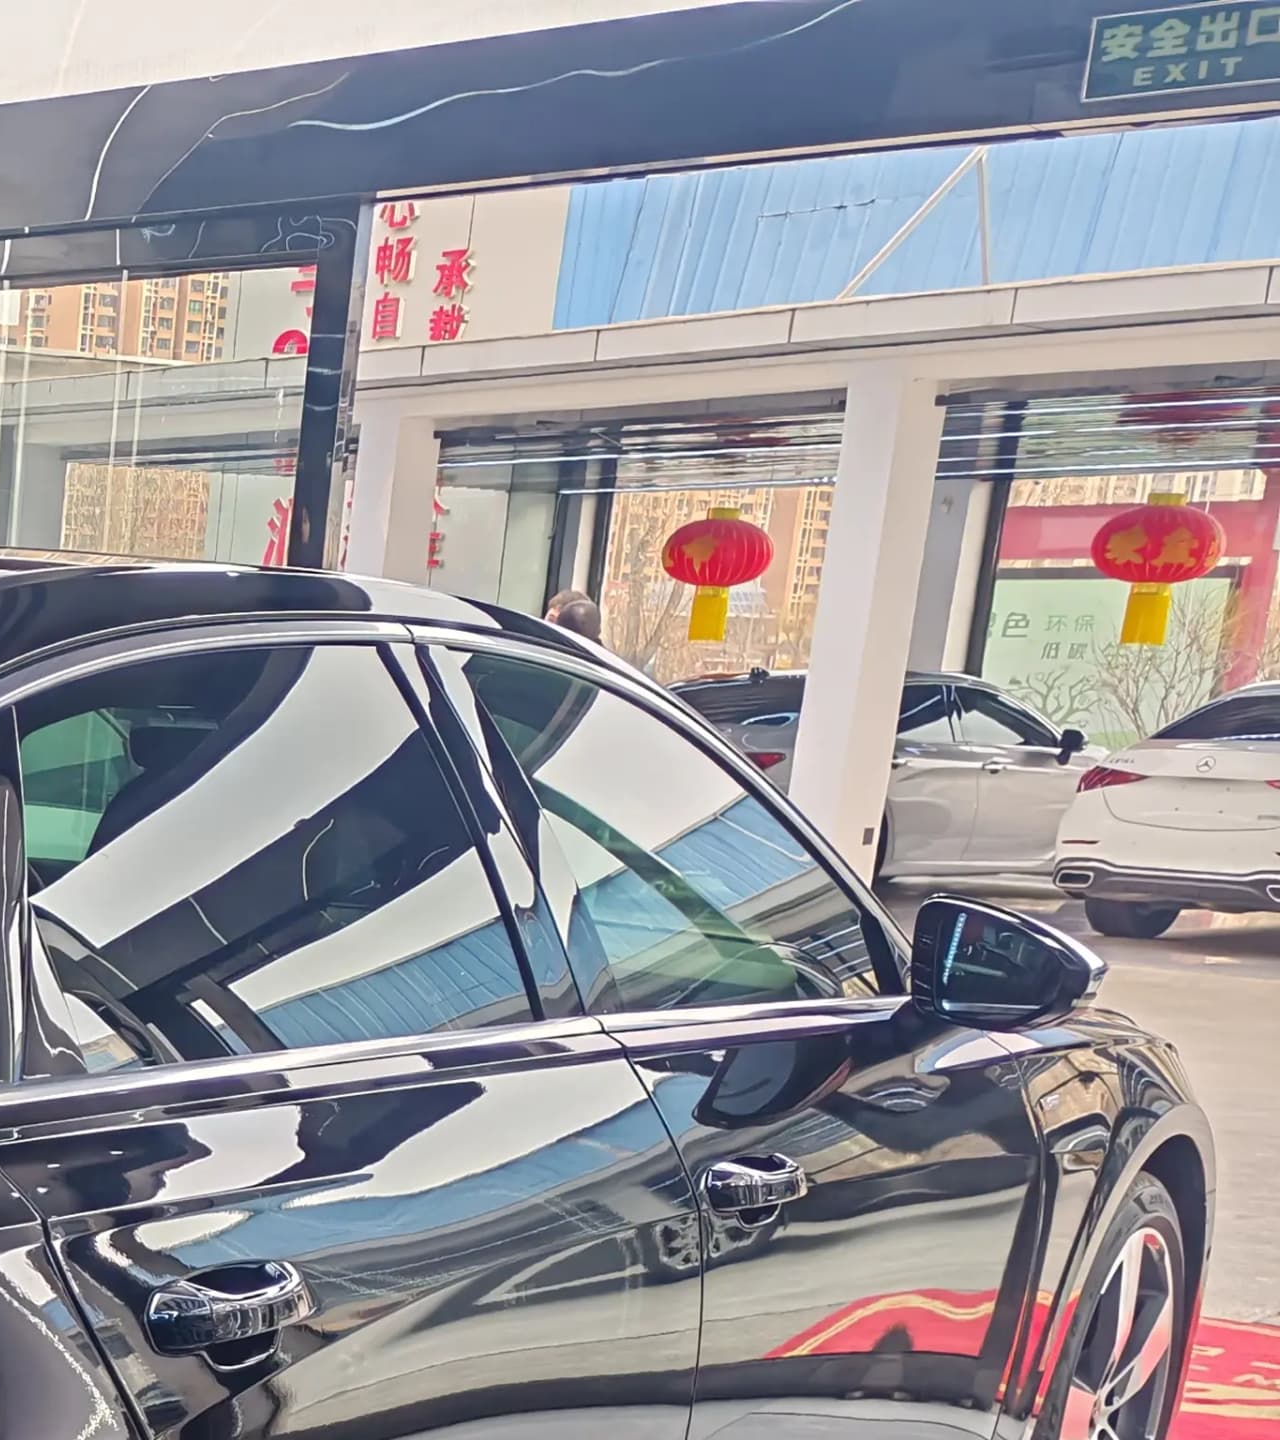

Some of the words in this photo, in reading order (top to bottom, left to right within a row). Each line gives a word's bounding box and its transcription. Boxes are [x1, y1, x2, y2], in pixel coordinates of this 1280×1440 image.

[1100, 6, 1279, 62] 安全出口
[1132, 56, 1243, 87] EXIT
